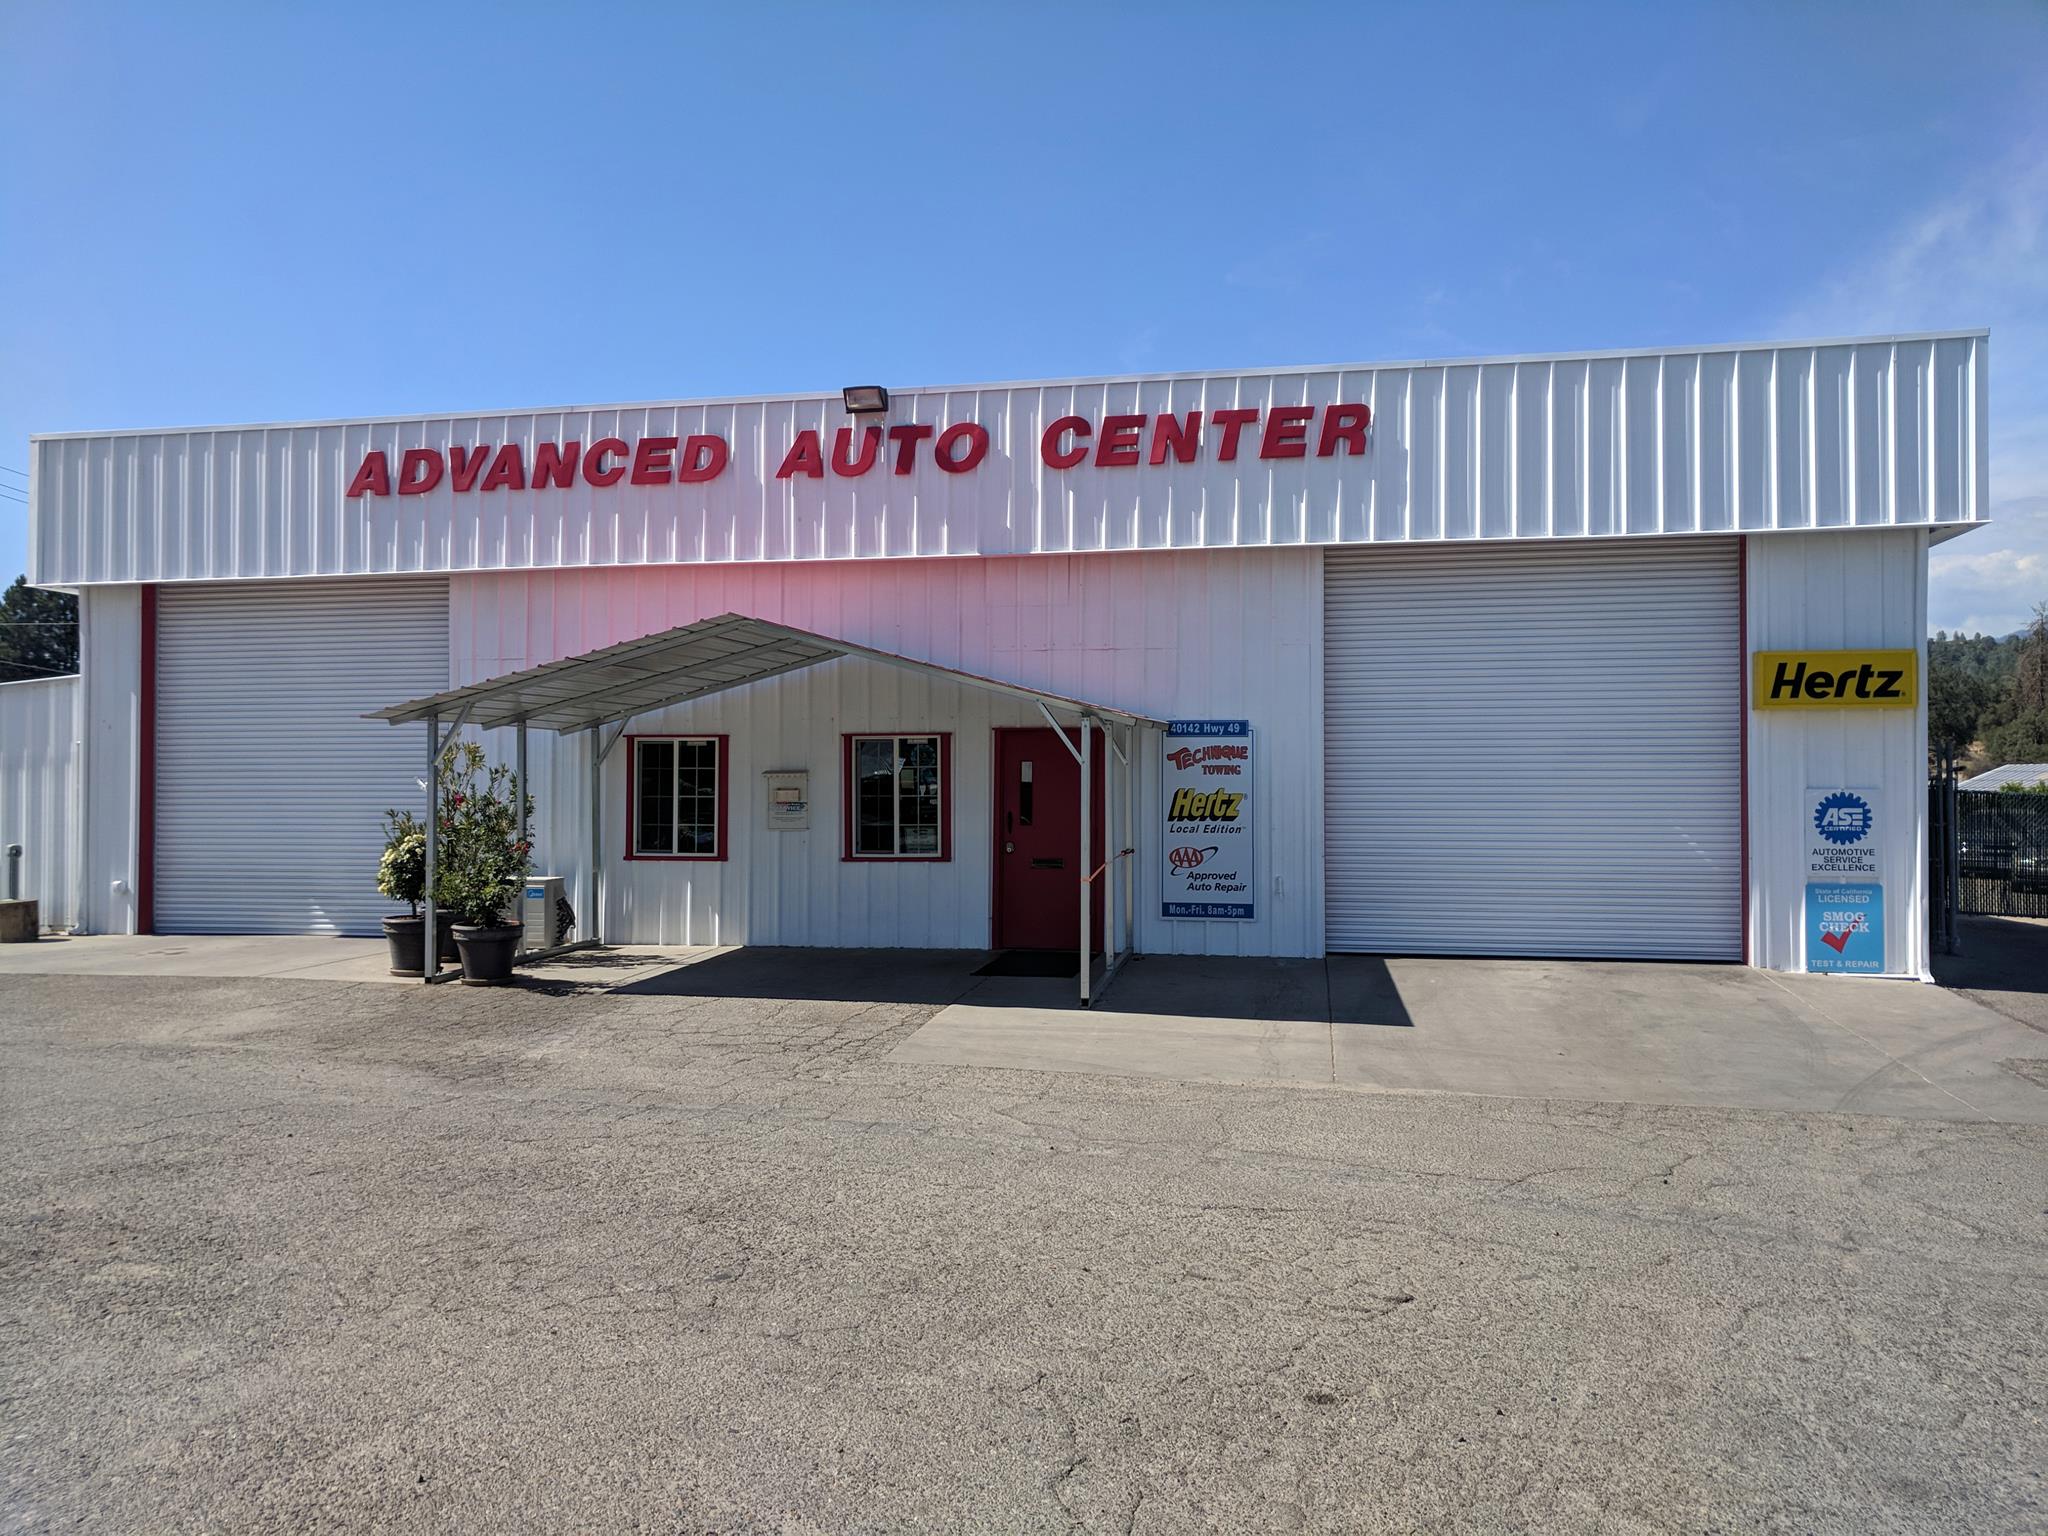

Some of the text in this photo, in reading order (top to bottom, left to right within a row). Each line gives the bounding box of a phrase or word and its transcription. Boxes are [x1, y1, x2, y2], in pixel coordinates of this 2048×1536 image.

[346, 403, 1372, 498] ADVANCED AUTO CENTER
[1770, 662, 1904, 699] Hertz
[1171, 723, 1240, 735] 40142 Hwy 49
[1167, 745, 1249, 770] TECHNIQUE
[1201, 765, 1242, 775] TOWING
[1168, 788, 1243, 821] Hertz
[1821, 807, 1863, 826] ASE
[1169, 824, 1242, 834] Local Edition
[1812, 848, 1875, 856] AUTOMOTIVE
[1172, 848, 1201, 867] AAA
[1823, 856, 1863, 864] SERVICE
[1811, 863, 1875, 872] EXCELLENCE
[1186, 871, 1237, 881] Approved
[1186, 882, 1247, 893] Auto Repair
[1818, 894, 1870, 904] LICENSED
[1169, 904, 1245, 917] Mon.-Fri. 8am-5pm
[1823, 911, 1865, 921] SMOG
[1819, 922, 1870, 932] CHECK
[1811, 960, 1834, 968] TEST
[1845, 960, 1880, 968] REPAIR
